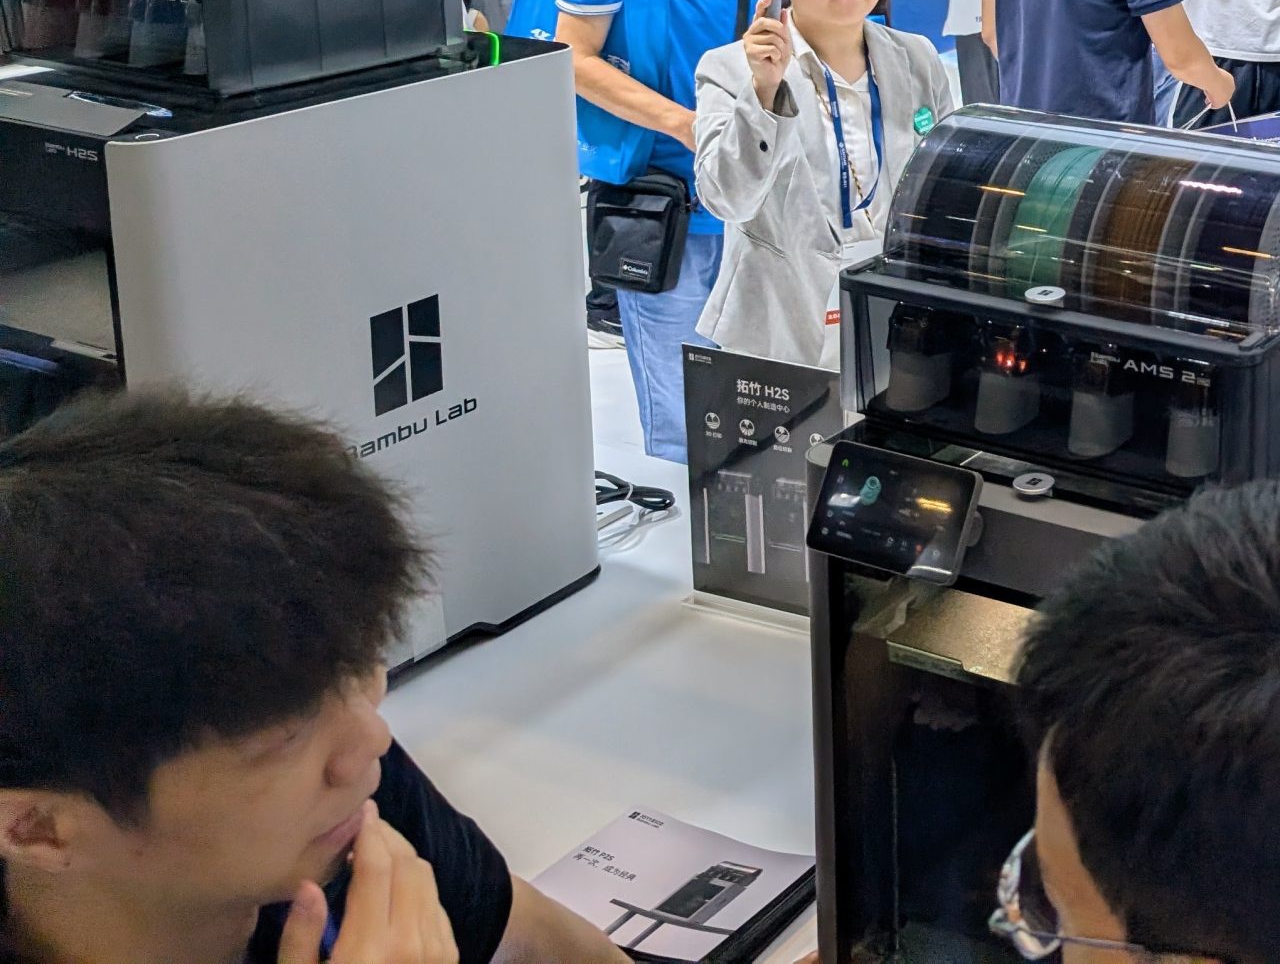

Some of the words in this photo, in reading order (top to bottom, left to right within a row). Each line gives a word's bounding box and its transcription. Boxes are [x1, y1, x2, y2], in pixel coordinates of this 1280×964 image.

[66, 144, 98, 162] H2S
[1123, 359, 1175, 380] AMS
[1181, 370, 1196, 384] 2
[736, 378, 762, 396] 拓竹
[764, 385, 790, 401] H2S
[435, 397, 478, 426] Lab
